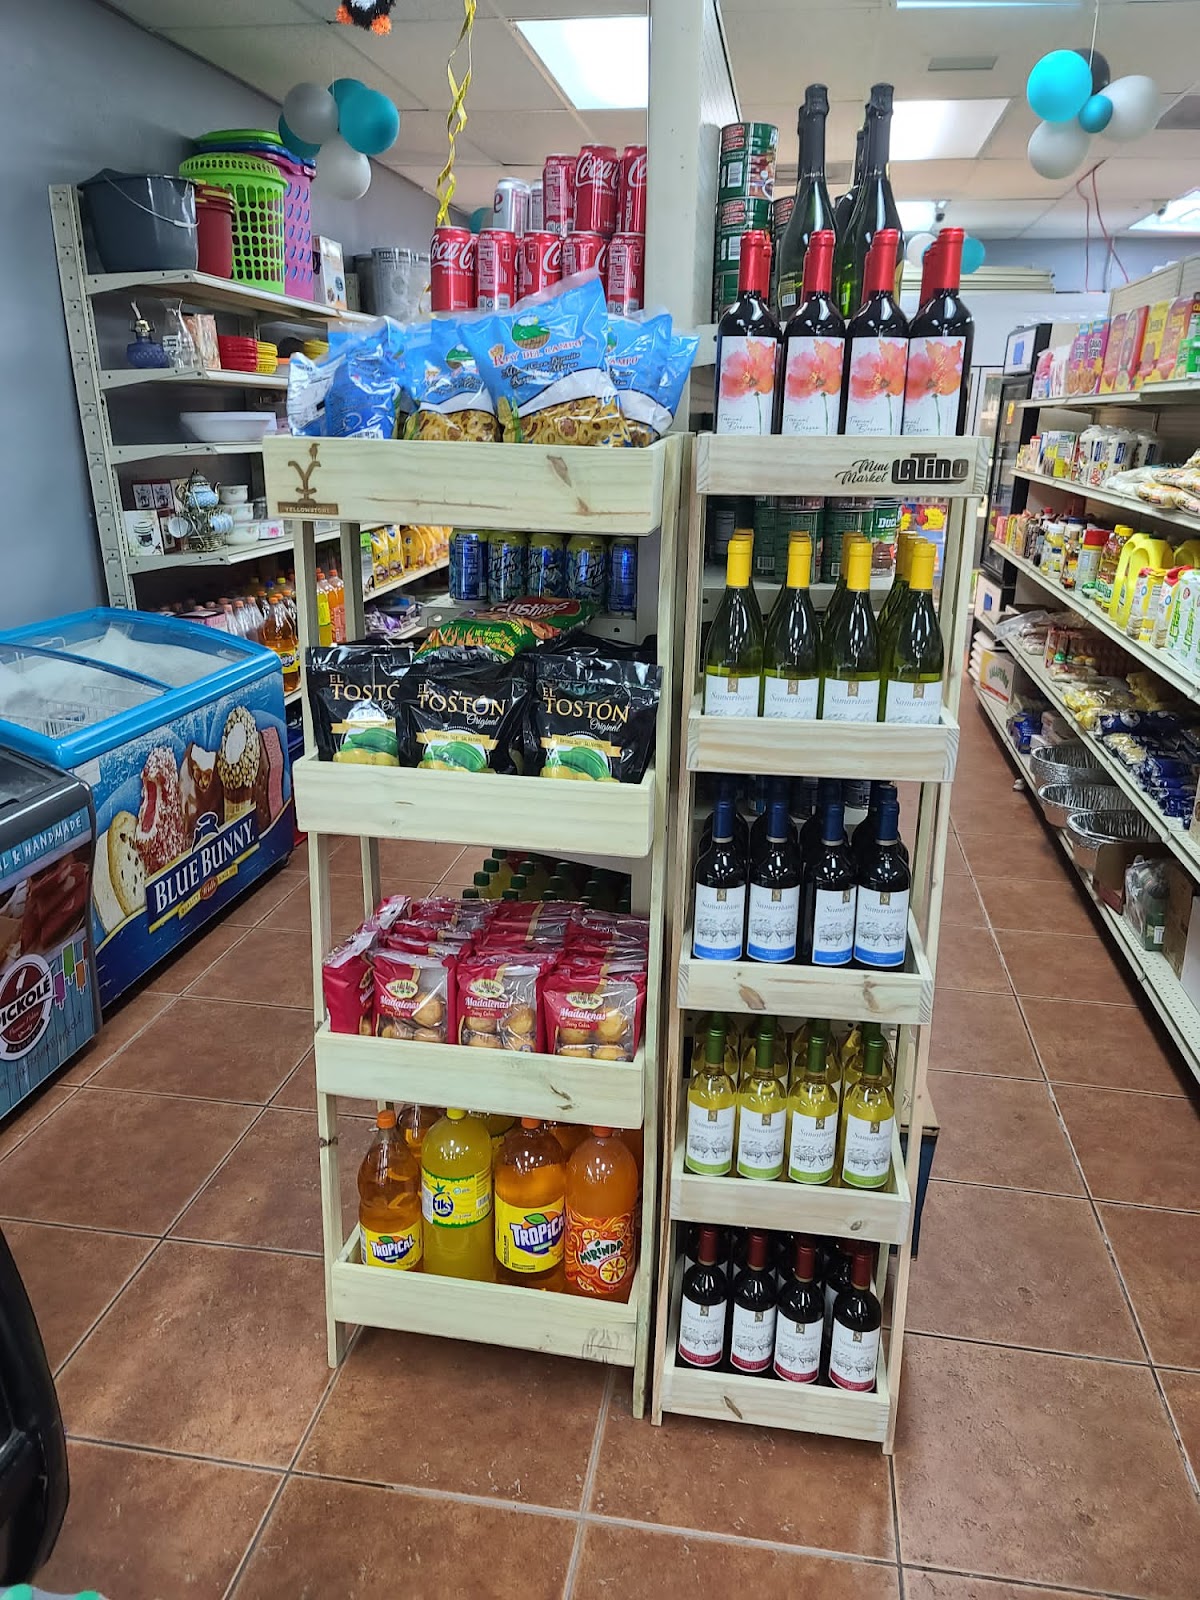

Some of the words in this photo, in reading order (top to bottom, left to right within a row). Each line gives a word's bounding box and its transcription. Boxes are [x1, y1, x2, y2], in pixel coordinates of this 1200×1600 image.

[609, 356, 638, 366] AMPO
[851, 459, 889, 473] Mini
[835, 472, 888, 485] Market
[330, 674, 344, 684] EL
[330, 680, 400, 701] TOSTÓ
[418, 683, 429, 694] EL
[543, 687, 556, 698] EL
[417, 693, 506, 716] TOSTÓN
[543, 697, 631, 723] TOSTÓN
[466, 713, 500, 729] Original
[590, 718, 623, 735] Original
[12, 850, 21, 865] &
[25, 815, 82, 857] HANDMADE
[154, 858, 200, 914] BLUE
[0, 975, 52, 1026] ICKOLÉ
[465, 996, 509, 1009] Madalenas
[559, 1007, 607, 1022] Madalenas
